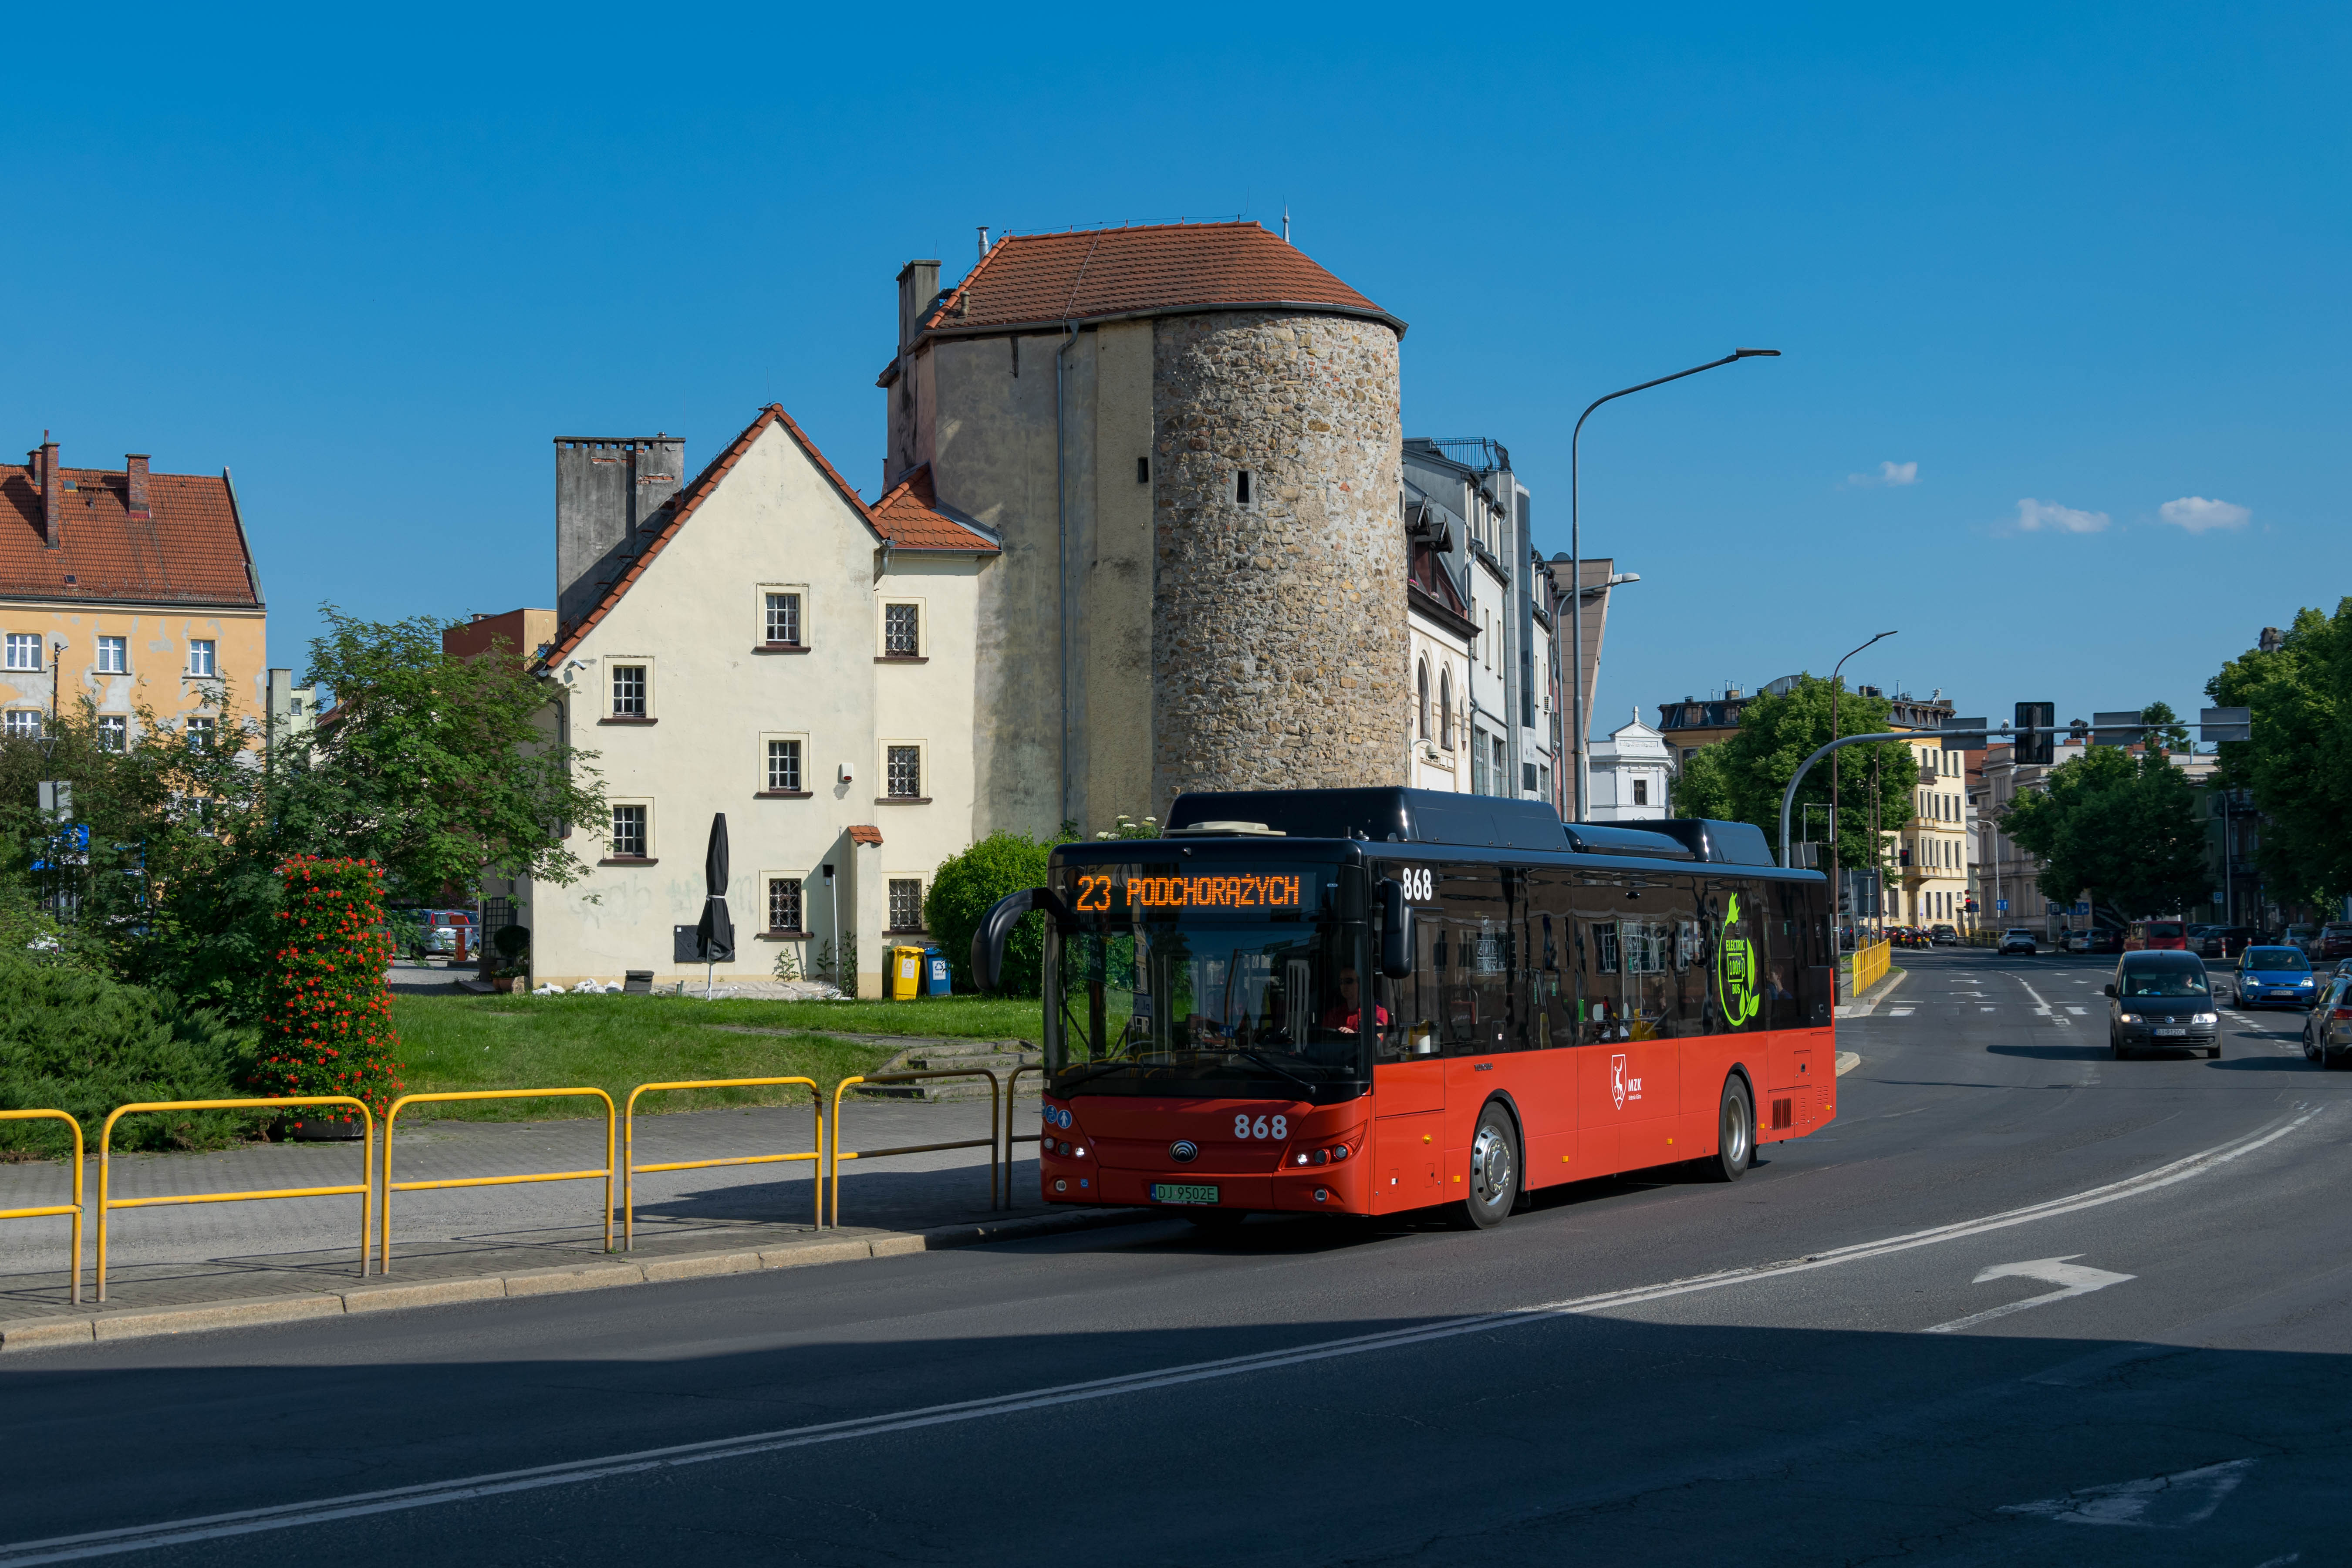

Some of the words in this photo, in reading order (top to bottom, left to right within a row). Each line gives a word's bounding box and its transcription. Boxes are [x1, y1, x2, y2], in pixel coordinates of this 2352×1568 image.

[1403, 867, 1432, 900] 868
[1077, 876, 1111, 910] 23
[1127, 874, 1299, 907] PODCHORĄŻYCH
[1726, 940, 1745, 951] ELECTRIC
[1730, 960, 1741, 975] 100%
[1732, 984, 1740, 994] BUS
[1628, 1078, 1641, 1092] MZK
[1235, 1114, 1287, 1139] 868
[1158, 1186, 1172, 1198] DJ
[1178, 1187, 1215, 1200] 9502E
